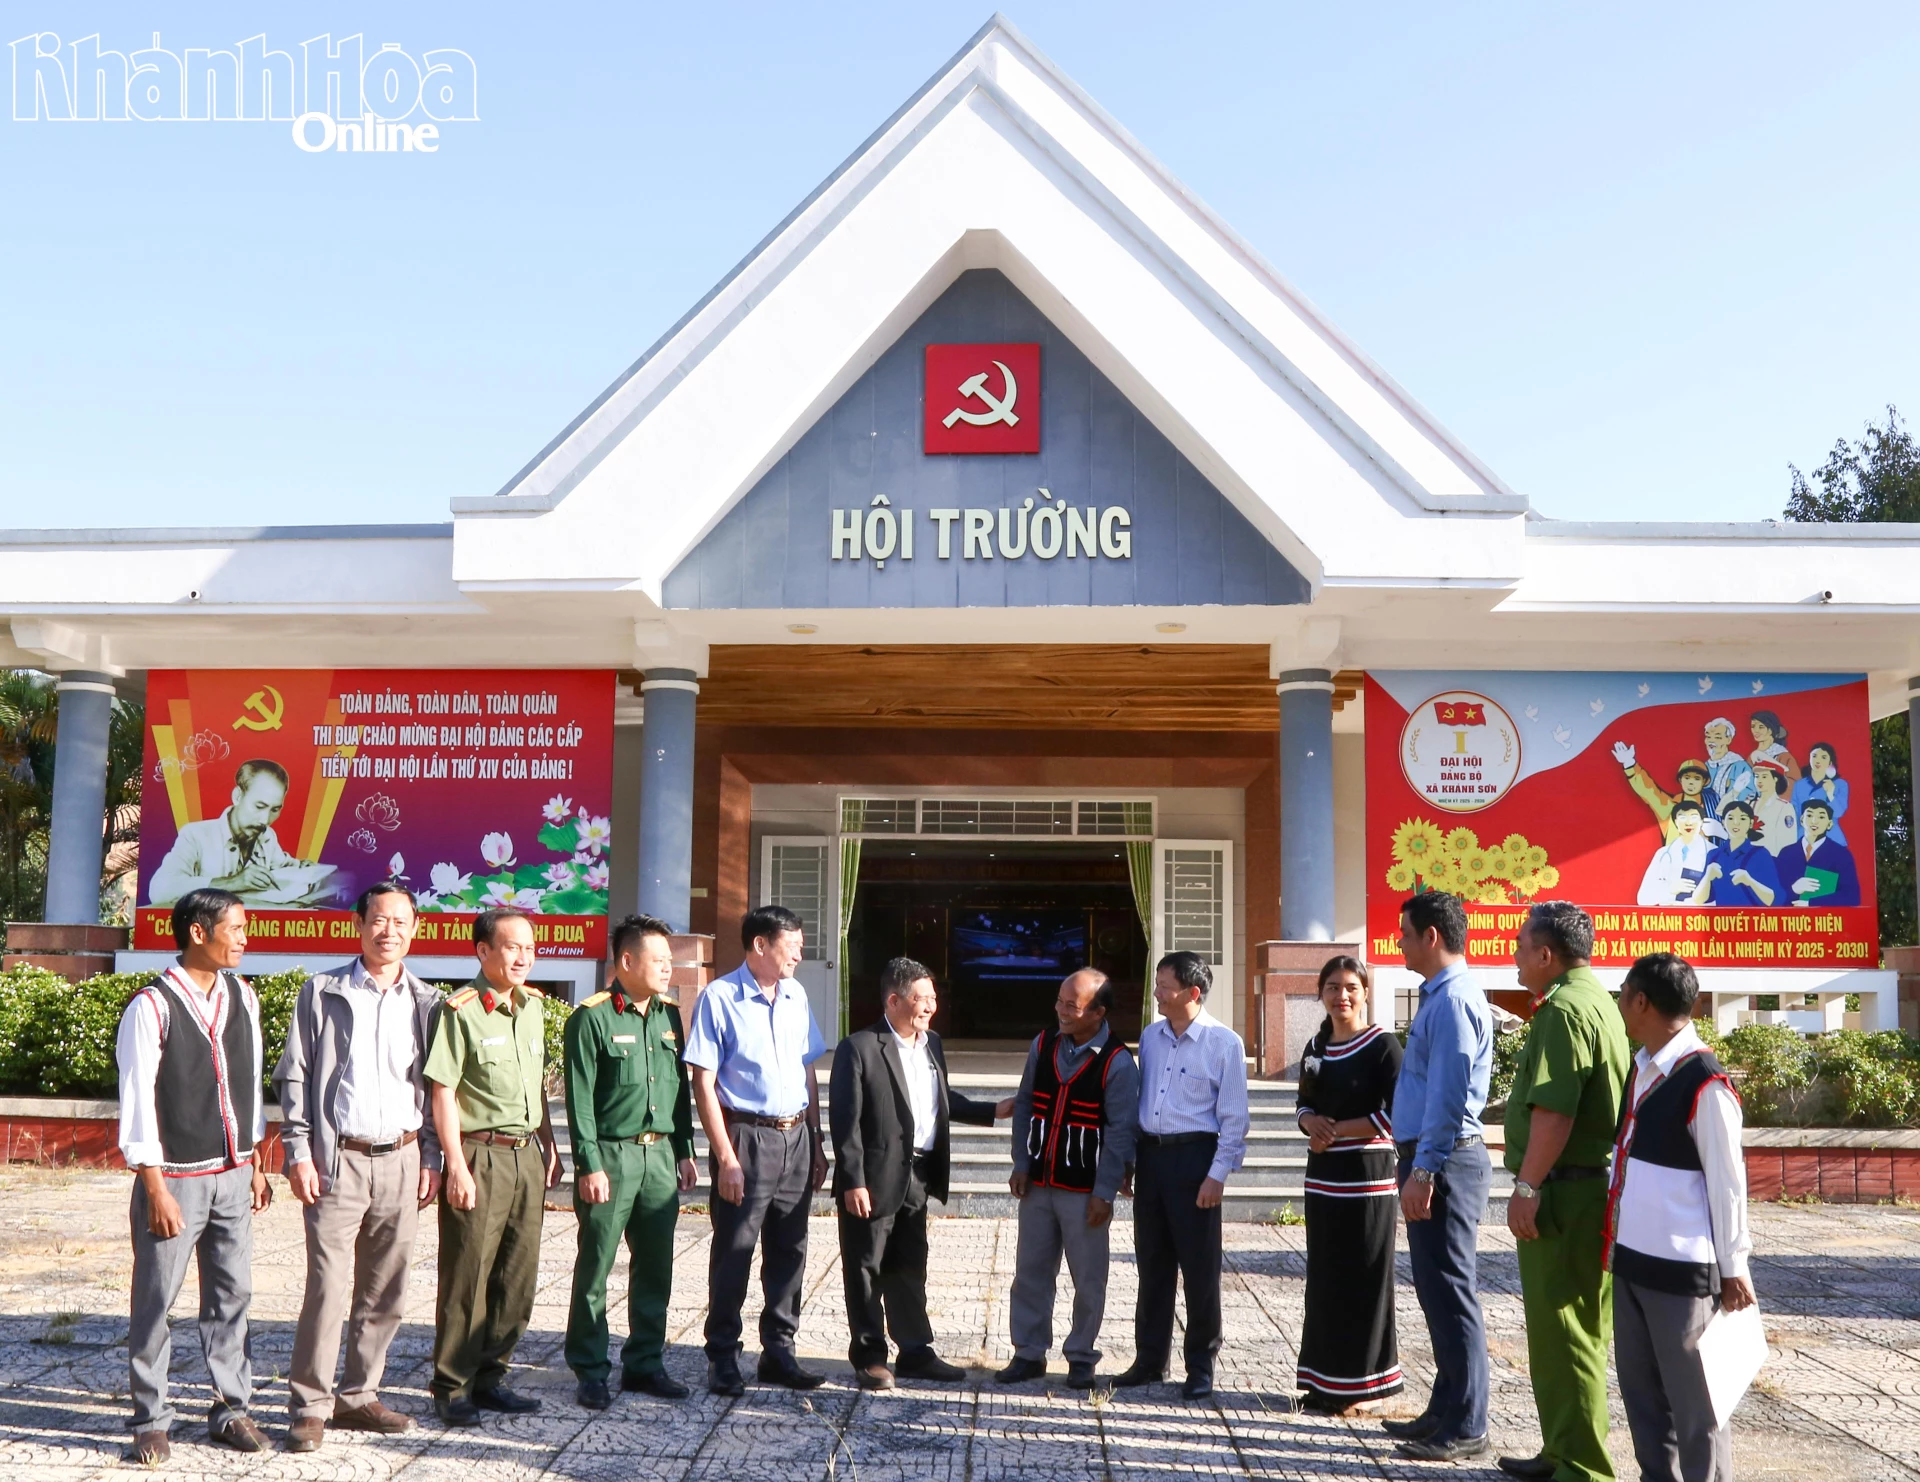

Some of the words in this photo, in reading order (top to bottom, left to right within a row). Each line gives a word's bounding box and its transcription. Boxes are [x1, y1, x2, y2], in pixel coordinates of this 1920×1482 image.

[831, 494, 913, 569] HỘI
[929, 487, 1131, 559] TRƯỜNG
[340, 690, 372, 714] TOÀN
[375, 688, 413, 716] ĐẢNG,
[416, 690, 449, 714] TOÀN
[453, 691, 482, 716] DÂN,
[486, 691, 519, 715] TOÀN
[522, 691, 557, 716] QUÂN
[313, 725, 332, 746] THI
[335, 726, 359, 746] ĐUA
[362, 722, 396, 746] CHÀO
[400, 722, 436, 746] MỪNG
[440, 726, 462, 750] ĐẠI
[465, 723, 486, 750] HỘI
[489, 720, 524, 747] ĐẢNG
[527, 722, 553, 747] CÁC
[557, 720, 583, 747] CẤP
[1453, 731, 1468, 753] I
[321, 751, 349, 778] TIẾN
[352, 754, 371, 778] TỚI
[374, 758, 396, 782] ĐẠI
[399, 754, 420, 782] HỘI
[424, 752, 448, 779] LẦN
[451, 756, 477, 779] THỨ
[478, 759, 499, 779] XIV
[502, 753, 527, 779] CỦA
[1440, 757, 1459, 769] ĐẠI
[1463, 755, 1482, 769] HỘI
[1440, 769, 1466, 781] ĐẢNG
[1469, 771, 1482, 782] BỘ
[1426, 783, 1439, 793] XÃ
[1441, 783, 1475, 793] KHÁNH
[1478, 784, 1497, 793] SƠN
[284, 917, 326, 938] NGÀY
[443, 917, 473, 940] TẢN
[533, 925, 549, 942] HI
[1466, 910, 1494, 930] HÍNH
[1595, 912, 1619, 931] DÂN
[1623, 912, 1639, 931] XÃ
[1642, 912, 1682, 931] KHÁNH
[1686, 914, 1710, 932] SƠN
[1713, 911, 1750, 933] QUYẾT
[1753, 913, 1778, 932] TÂM
[1781, 914, 1812, 936] THỰC
[1815, 913, 1843, 936] HIỆN
[538, 945, 557, 955] CHÍ
[558, 947, 584, 956] MINH
[1469, 934, 1506, 958] QUYẾT
[1591, 937, 1608, 960] BỘ
[1611, 938, 1627, 957] XÃ
[1630, 938, 1670, 957] KHÁNH
[1674, 940, 1698, 958] SƠN
[1702, 937, 1725, 958] LẦN
[1778, 939, 1793, 958] KỲ
[1796, 942, 1825, 958] 2025
[1836, 942, 1869, 958] 2030!
